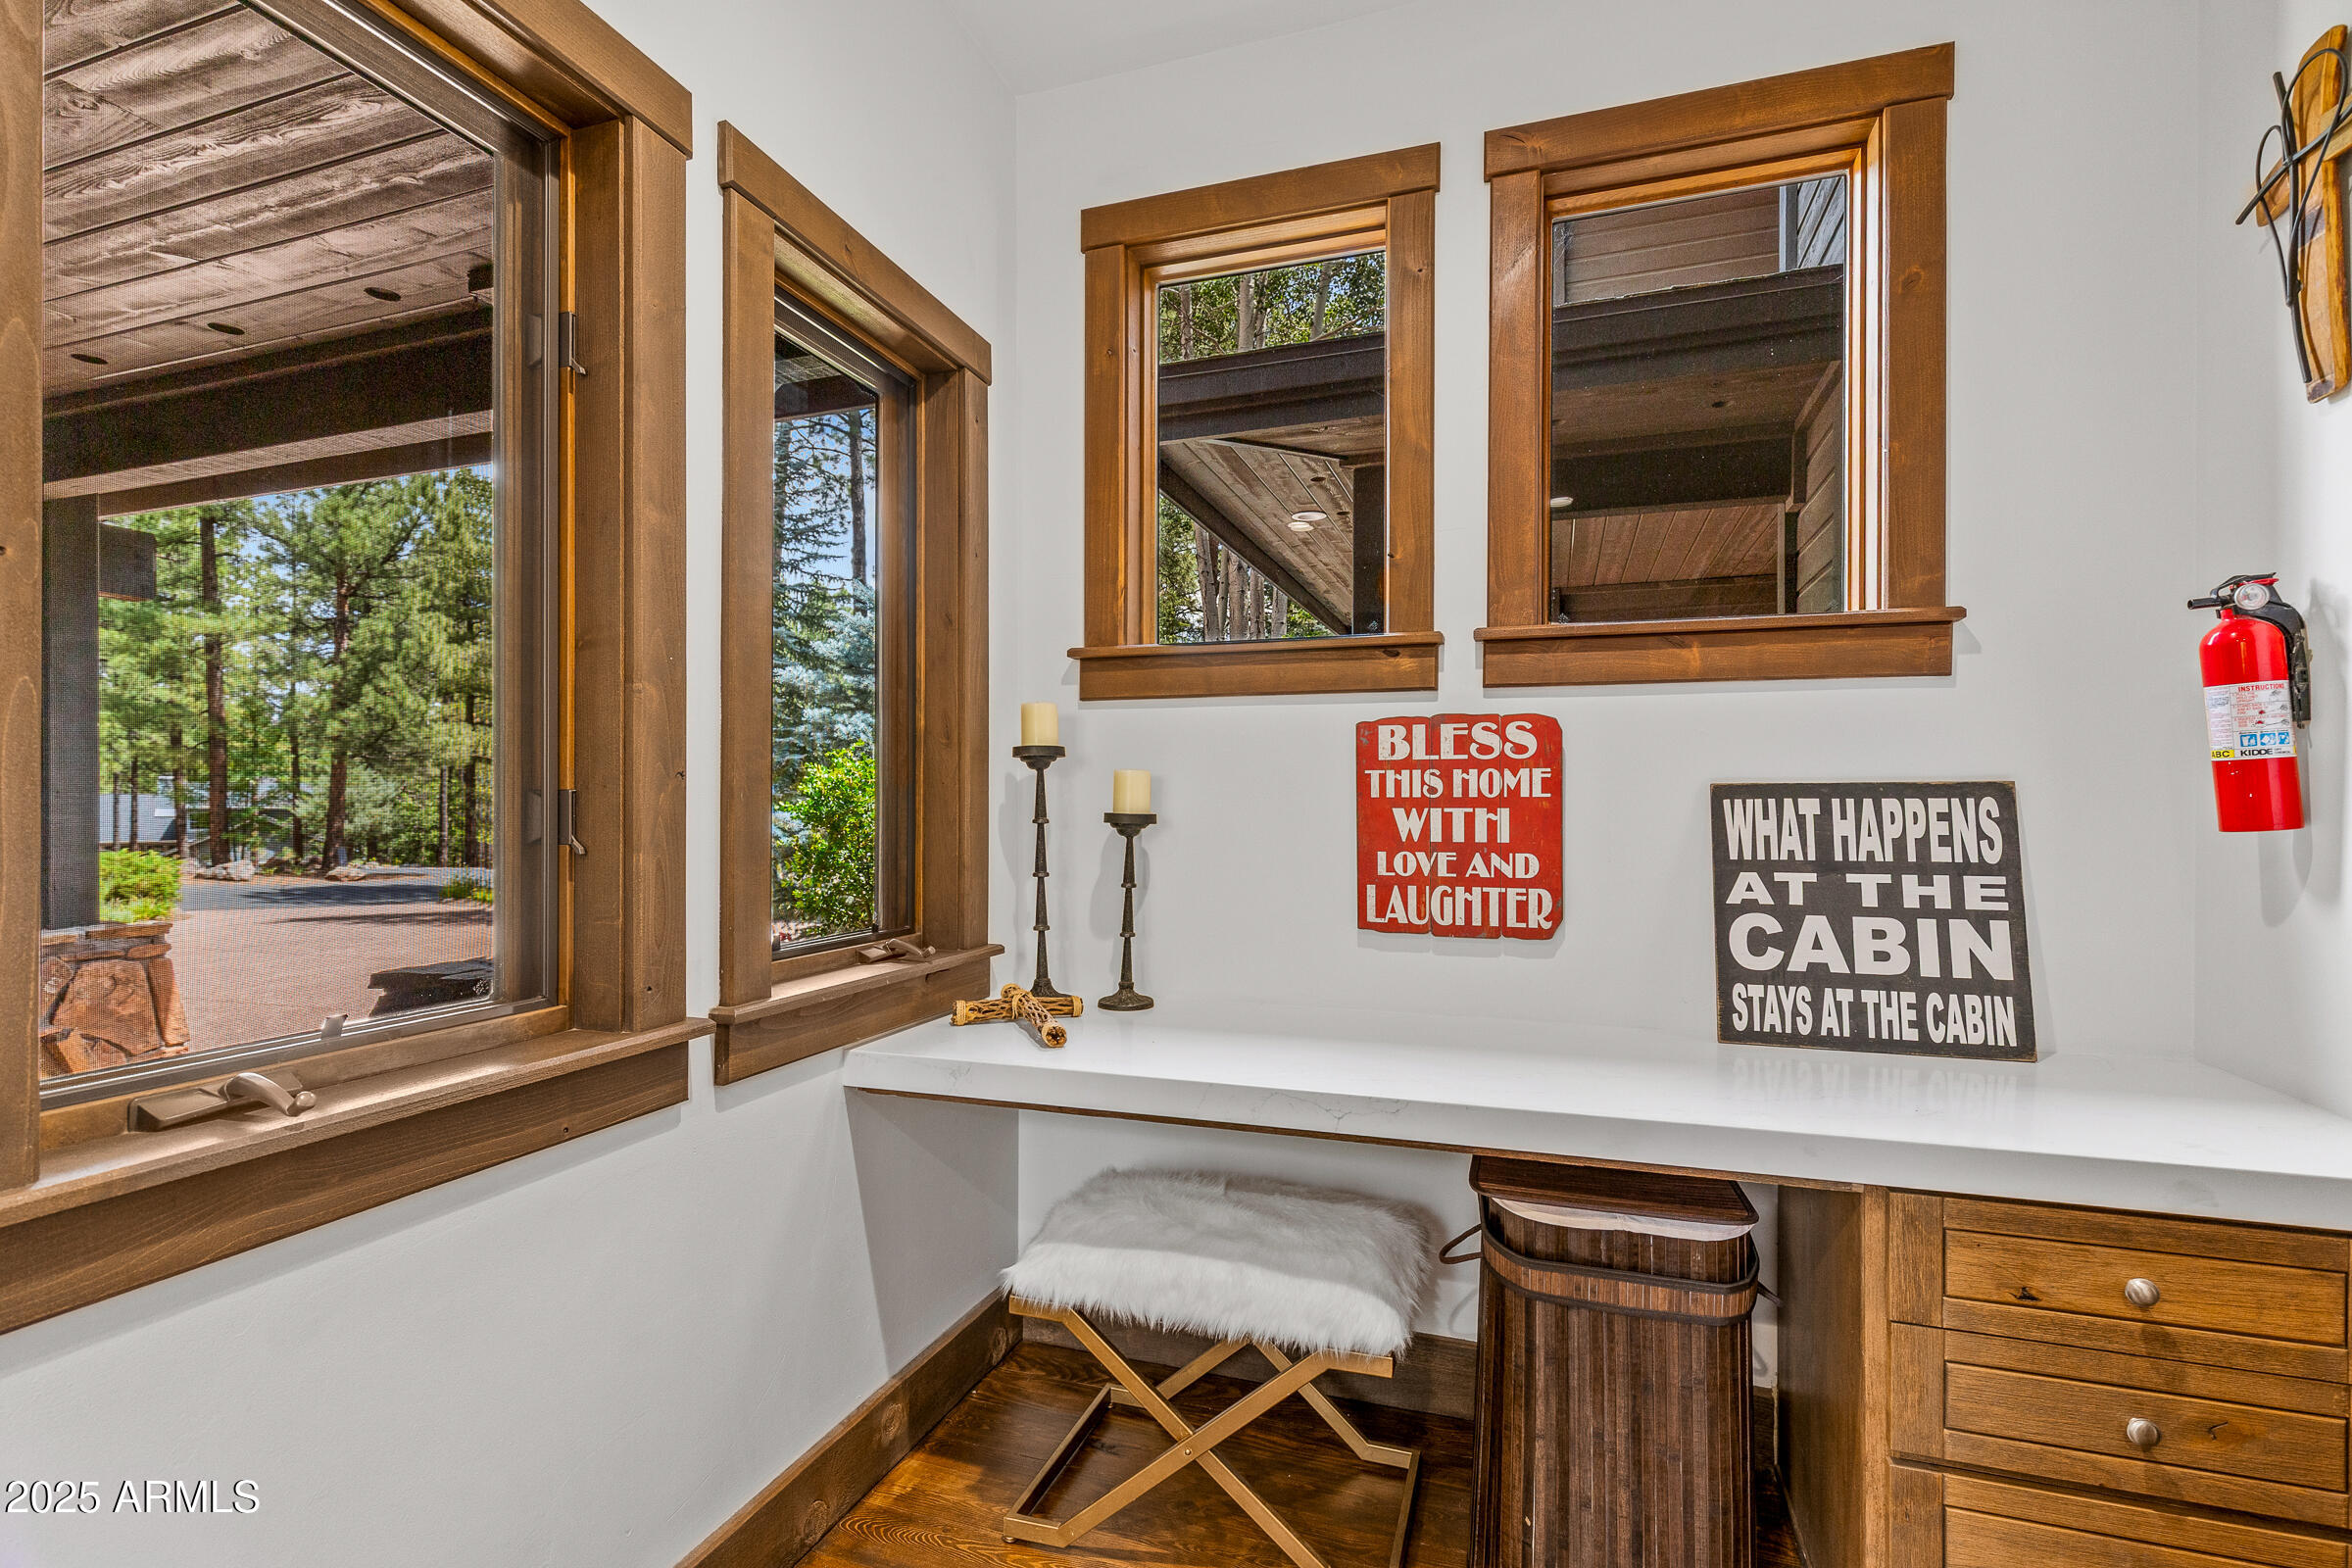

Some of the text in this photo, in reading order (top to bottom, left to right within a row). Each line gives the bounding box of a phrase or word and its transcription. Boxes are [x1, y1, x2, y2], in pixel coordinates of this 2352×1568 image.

[1377, 720, 1539, 761] BLESS
[2211, 750, 2230, 759] ABC
[2240, 748, 2274, 757] KIDDE
[1364, 767, 1552, 799] THIS HOME
[1392, 807, 1510, 844] WITH
[1722, 796, 2004, 864] WHAT HAPPENS
[1376, 851, 1541, 879] LOVE AND
[1365, 884, 1554, 930] LAUGHTER
[1724, 871, 2010, 911] AT THE
[1728, 912, 2015, 981] CABIN
[1731, 982, 2018, 1048] STAYS AT THE CABIN
